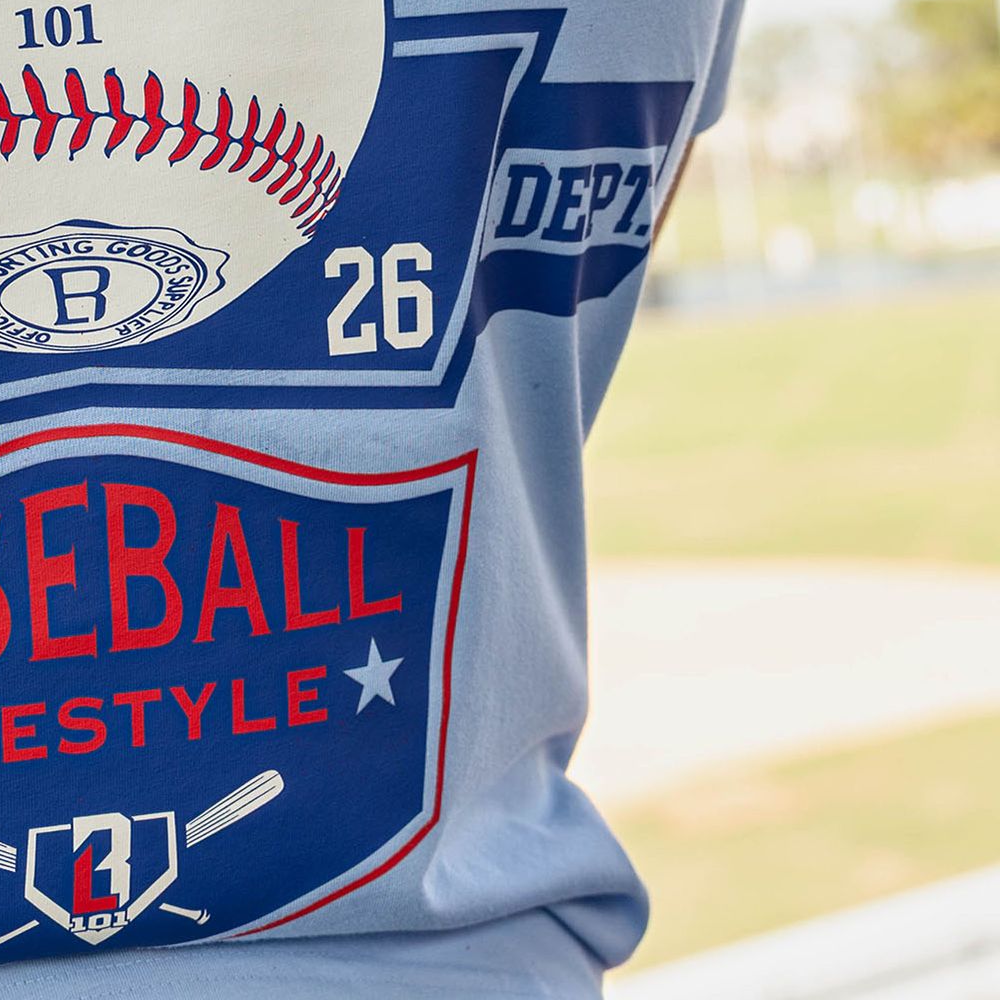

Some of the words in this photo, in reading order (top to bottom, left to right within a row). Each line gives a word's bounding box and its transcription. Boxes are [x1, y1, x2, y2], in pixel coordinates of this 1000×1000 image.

[15, 3, 102, 49] 101
[105, 240, 190, 275] GOODS
[115, 275, 194, 337] SUPPLIER
[324, 242, 434, 357] 26
[69, 911, 131, 934] 101
